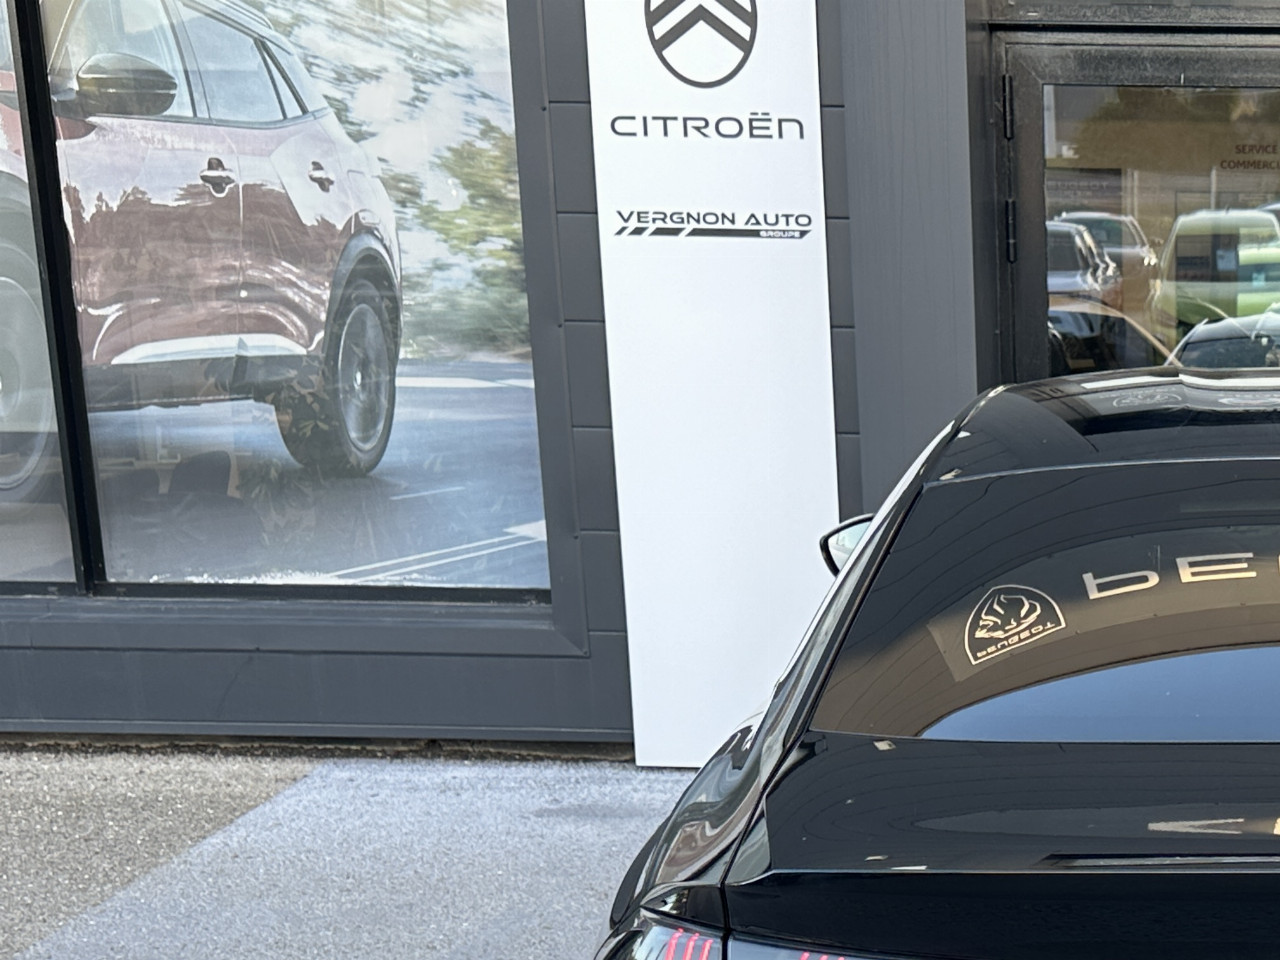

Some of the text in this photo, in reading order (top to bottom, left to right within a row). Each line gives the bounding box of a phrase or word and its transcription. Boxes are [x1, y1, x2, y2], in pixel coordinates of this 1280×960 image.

[610, 112, 804, 139] CITROËN
[1235, 144, 1278, 155] SERVICE
[616, 210, 812, 226] VERGNON AUTO
[759, 230, 801, 238] GROUPE
